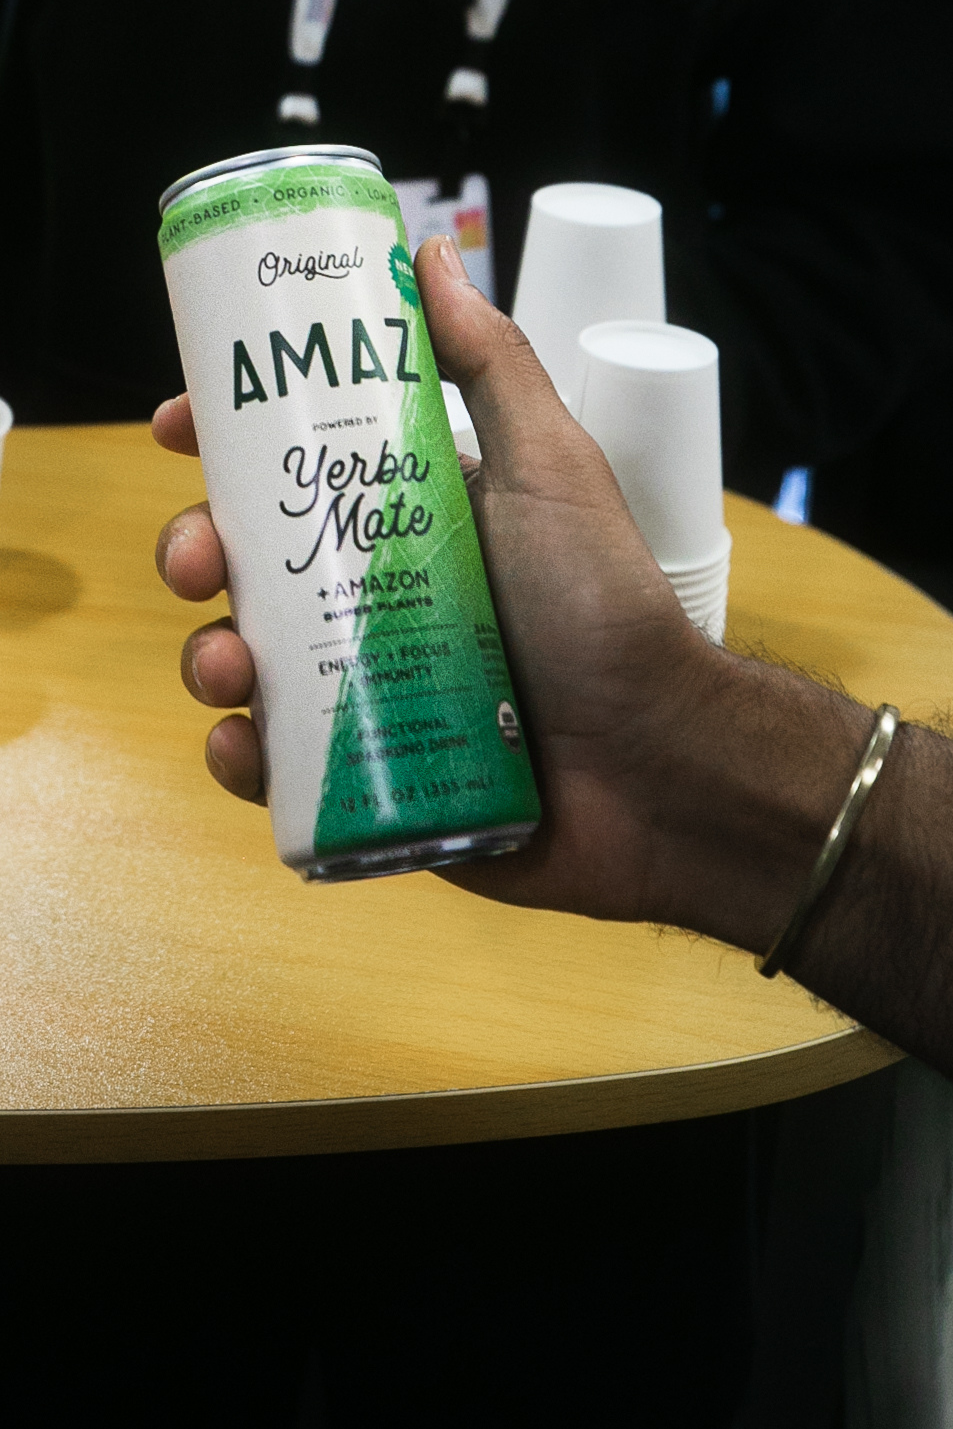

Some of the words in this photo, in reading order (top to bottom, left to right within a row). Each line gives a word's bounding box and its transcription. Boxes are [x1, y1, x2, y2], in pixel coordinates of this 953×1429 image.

[273, 185, 346, 202] ORGANIC
[258, 245, 364, 287] Original
[233, 317, 422, 411] AMAZ
[312, 417, 363, 432] POWERED
[279, 439, 430, 518] Yerba
[285, 492, 434, 574] Mate
[334, 568, 431, 599] AMAZON
